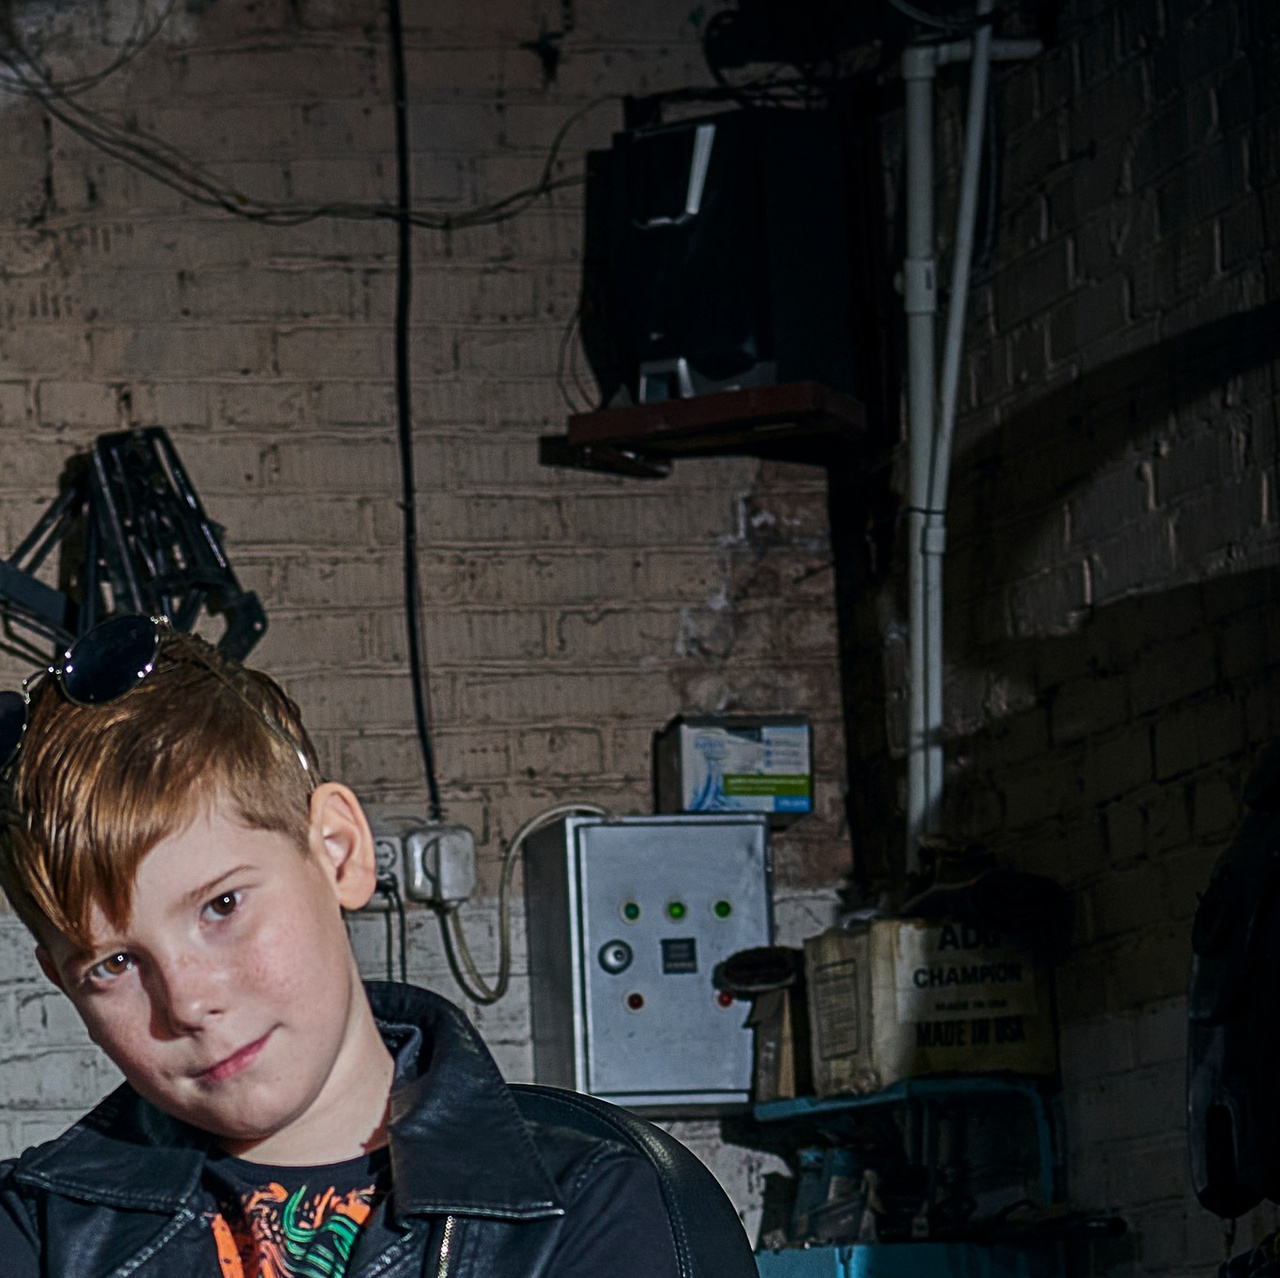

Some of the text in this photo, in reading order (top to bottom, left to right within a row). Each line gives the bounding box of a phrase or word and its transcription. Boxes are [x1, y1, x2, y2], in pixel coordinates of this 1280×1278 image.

[913, 963, 1023, 989] CHAMPION
[916, 1015, 1025, 1047] MADE IN USA
